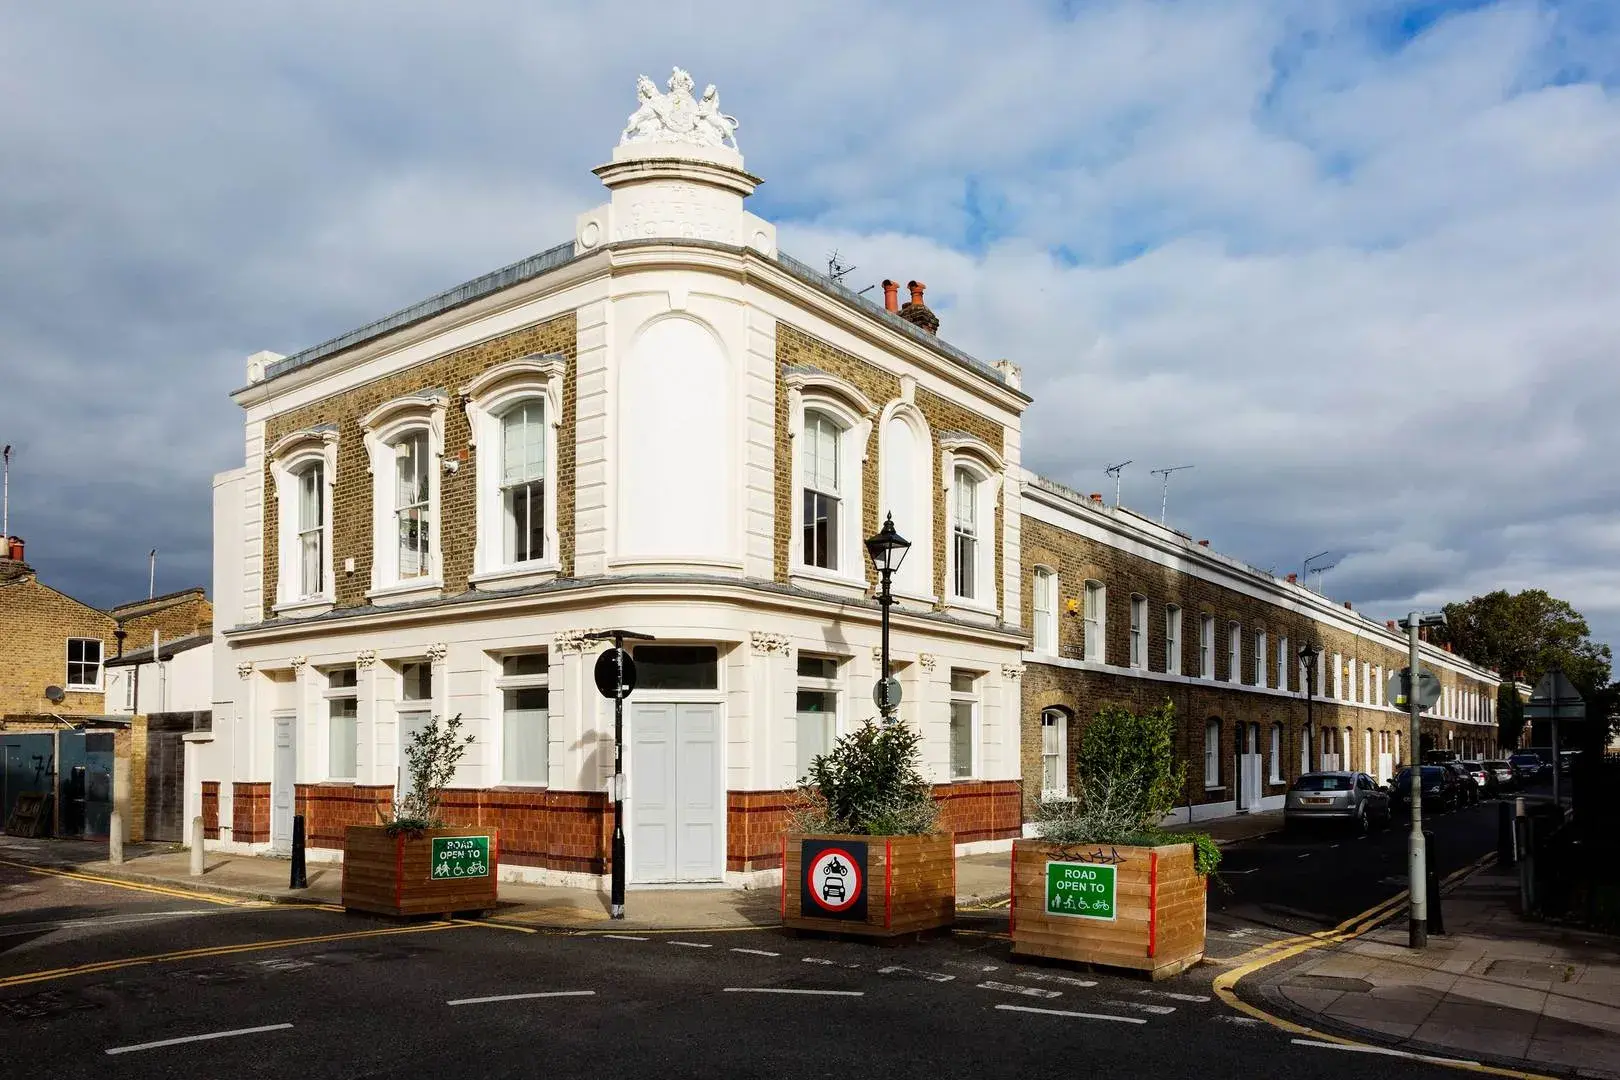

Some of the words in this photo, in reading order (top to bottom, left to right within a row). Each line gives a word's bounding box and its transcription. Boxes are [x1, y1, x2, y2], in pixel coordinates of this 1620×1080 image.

[447, 840, 474, 850] ROAD
[439, 850, 465, 860] OPEN
[467, 849, 480, 858] TO
[1064, 869, 1097, 880] ROAD
[1056, 880, 1087, 892] OPEN
[1089, 882, 1105, 893] TO
